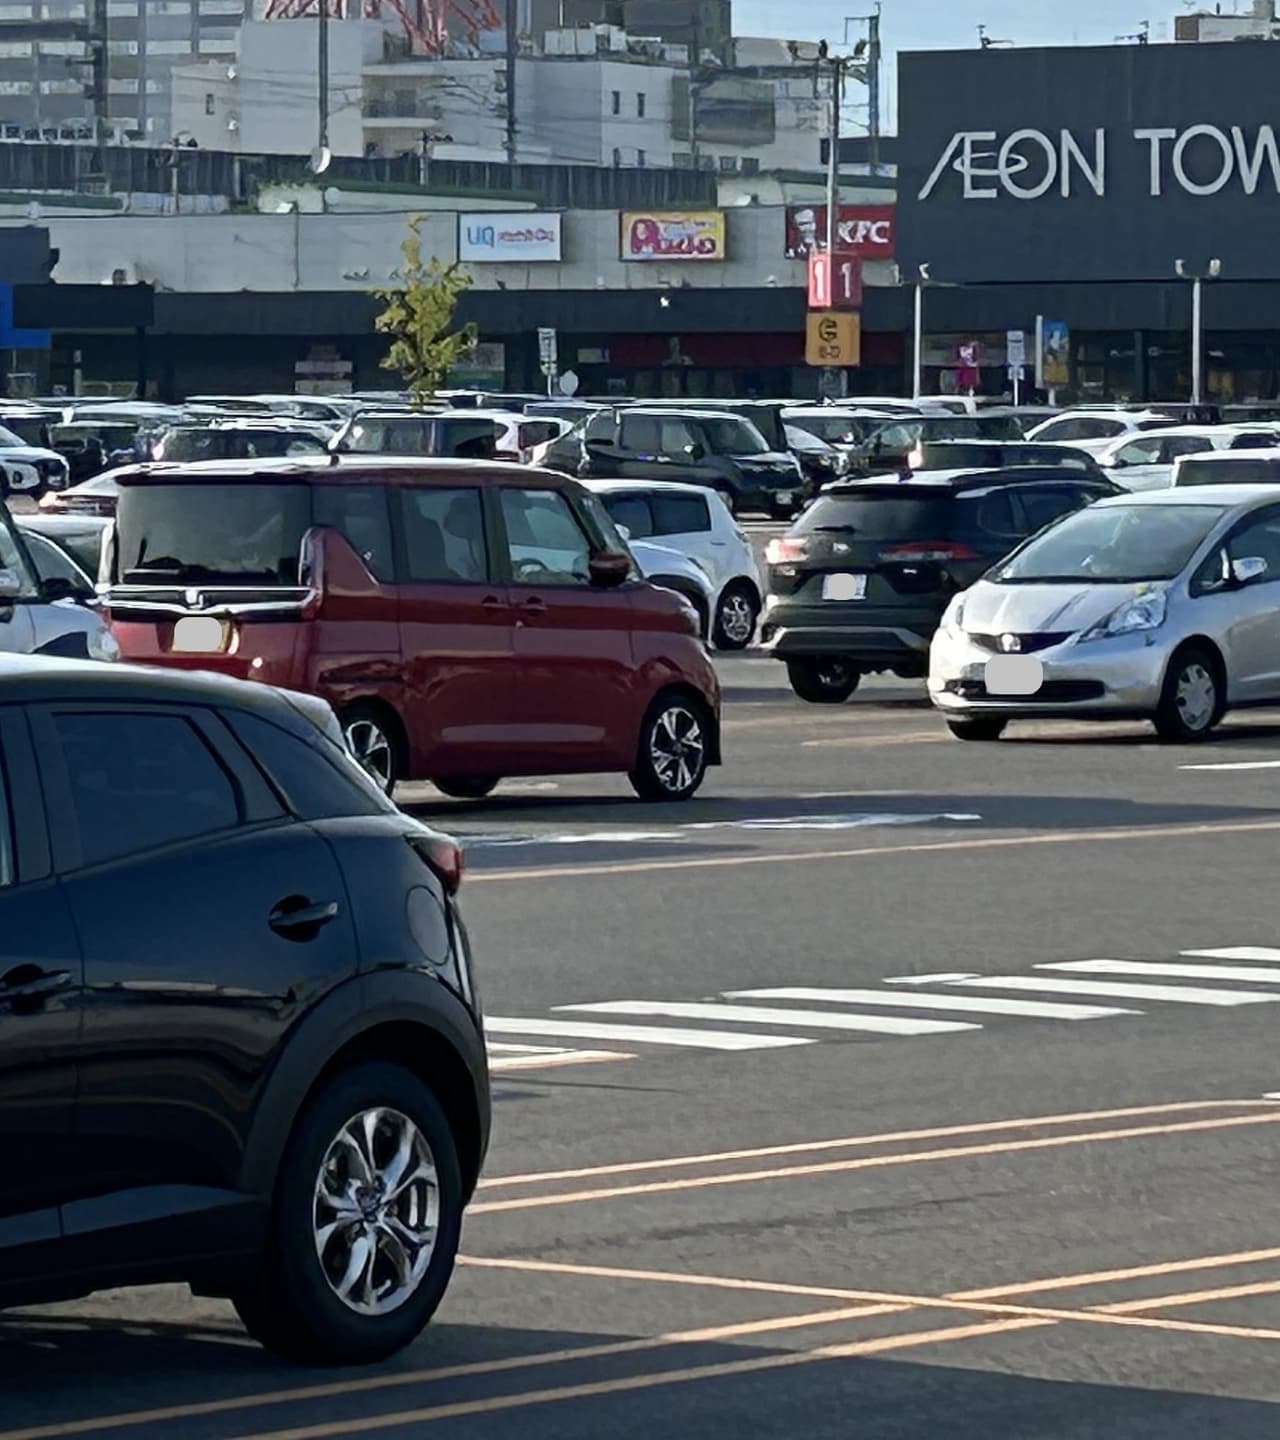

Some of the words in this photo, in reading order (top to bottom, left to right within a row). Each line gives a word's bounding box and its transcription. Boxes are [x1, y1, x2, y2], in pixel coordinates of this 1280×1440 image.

[838, 220, 891, 244] KFC
[814, 261, 825, 301] 1
[840, 261, 852, 299] 1
